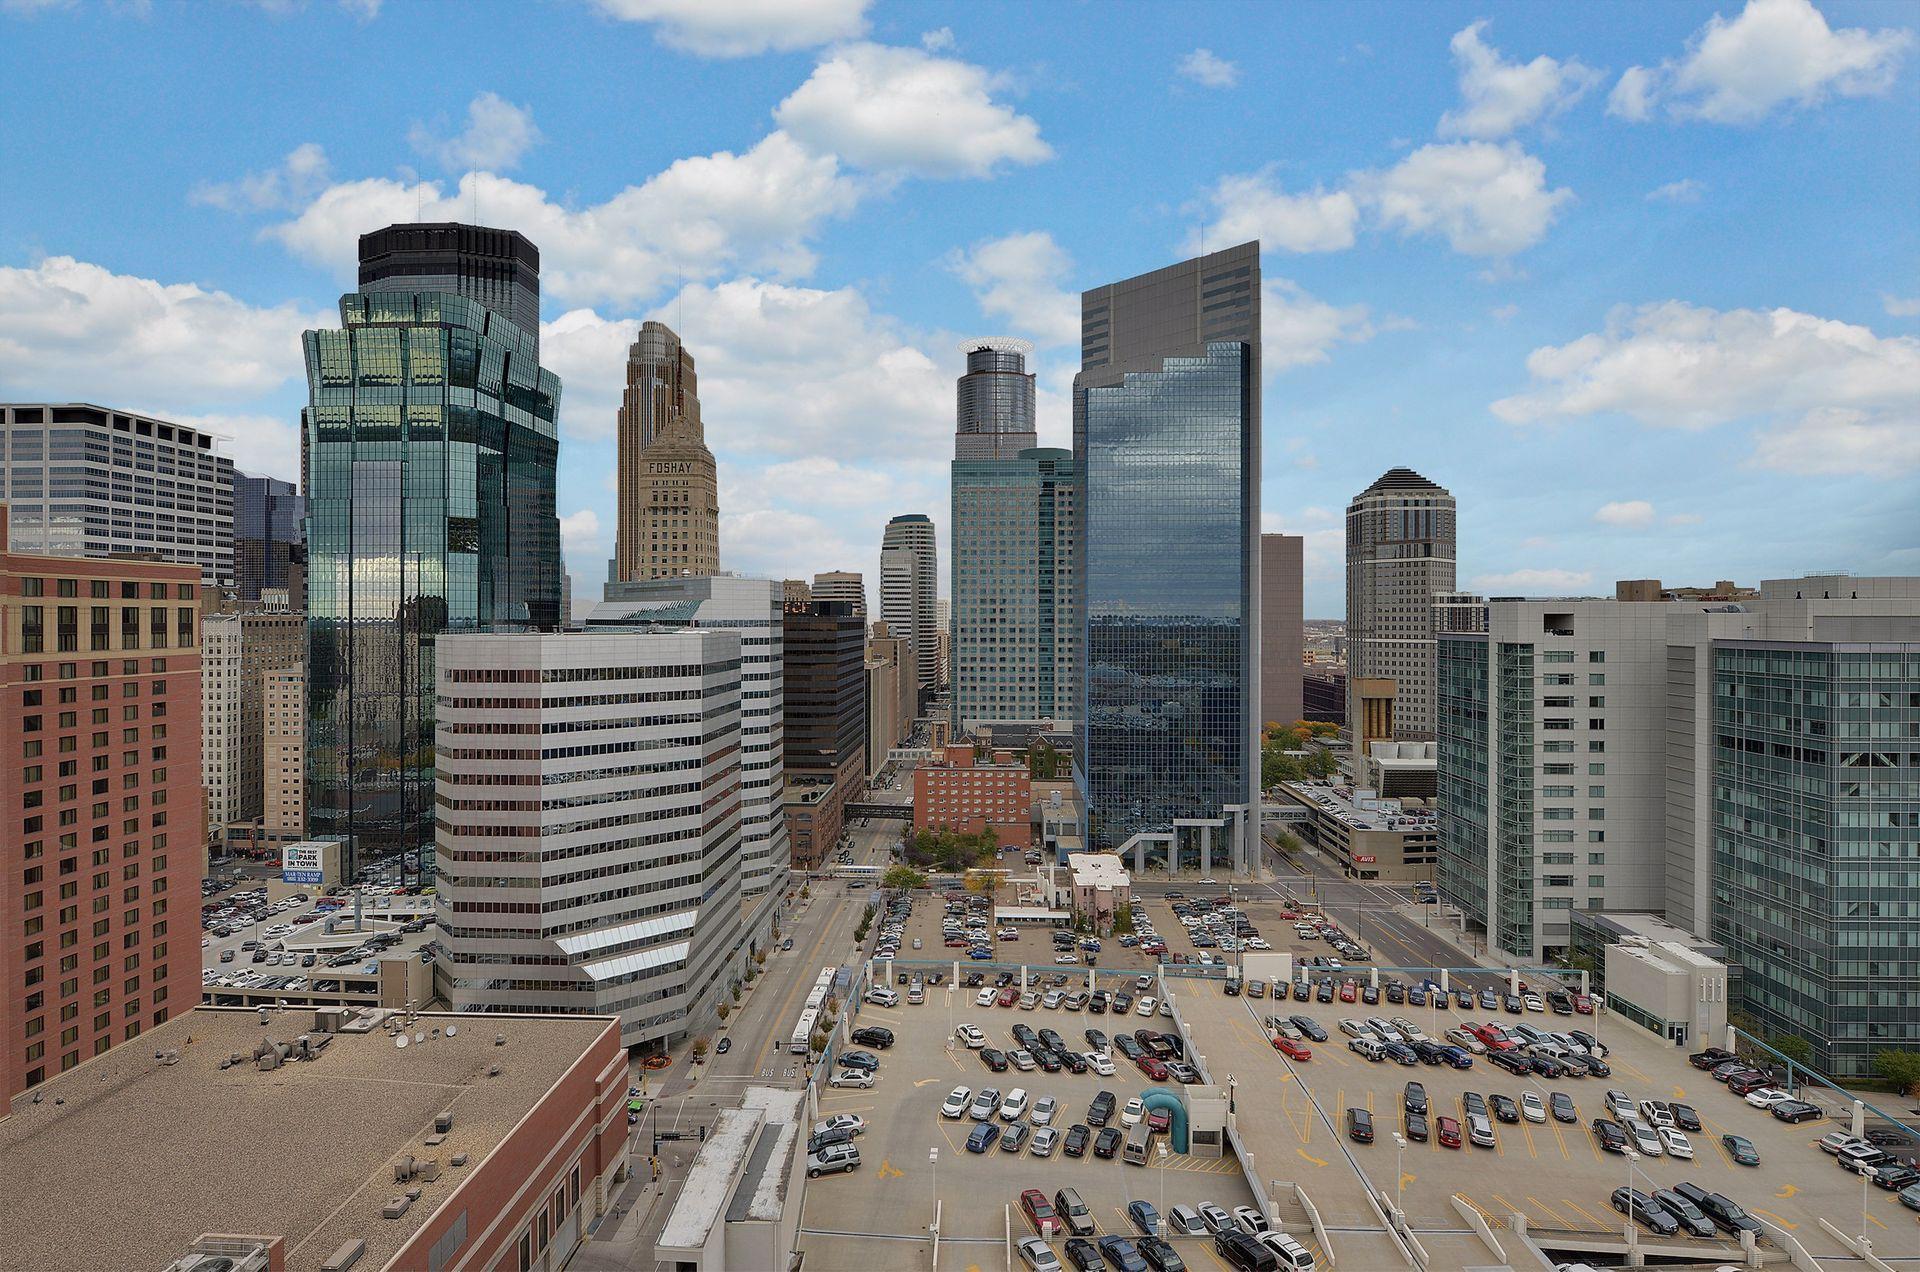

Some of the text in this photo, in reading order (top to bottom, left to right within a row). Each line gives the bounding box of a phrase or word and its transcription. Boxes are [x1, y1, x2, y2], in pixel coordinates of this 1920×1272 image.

[649, 463, 691, 473] FOSHAY
[761, 1068, 774, 1077] BUS
[783, 1068, 796, 1077] BUS
